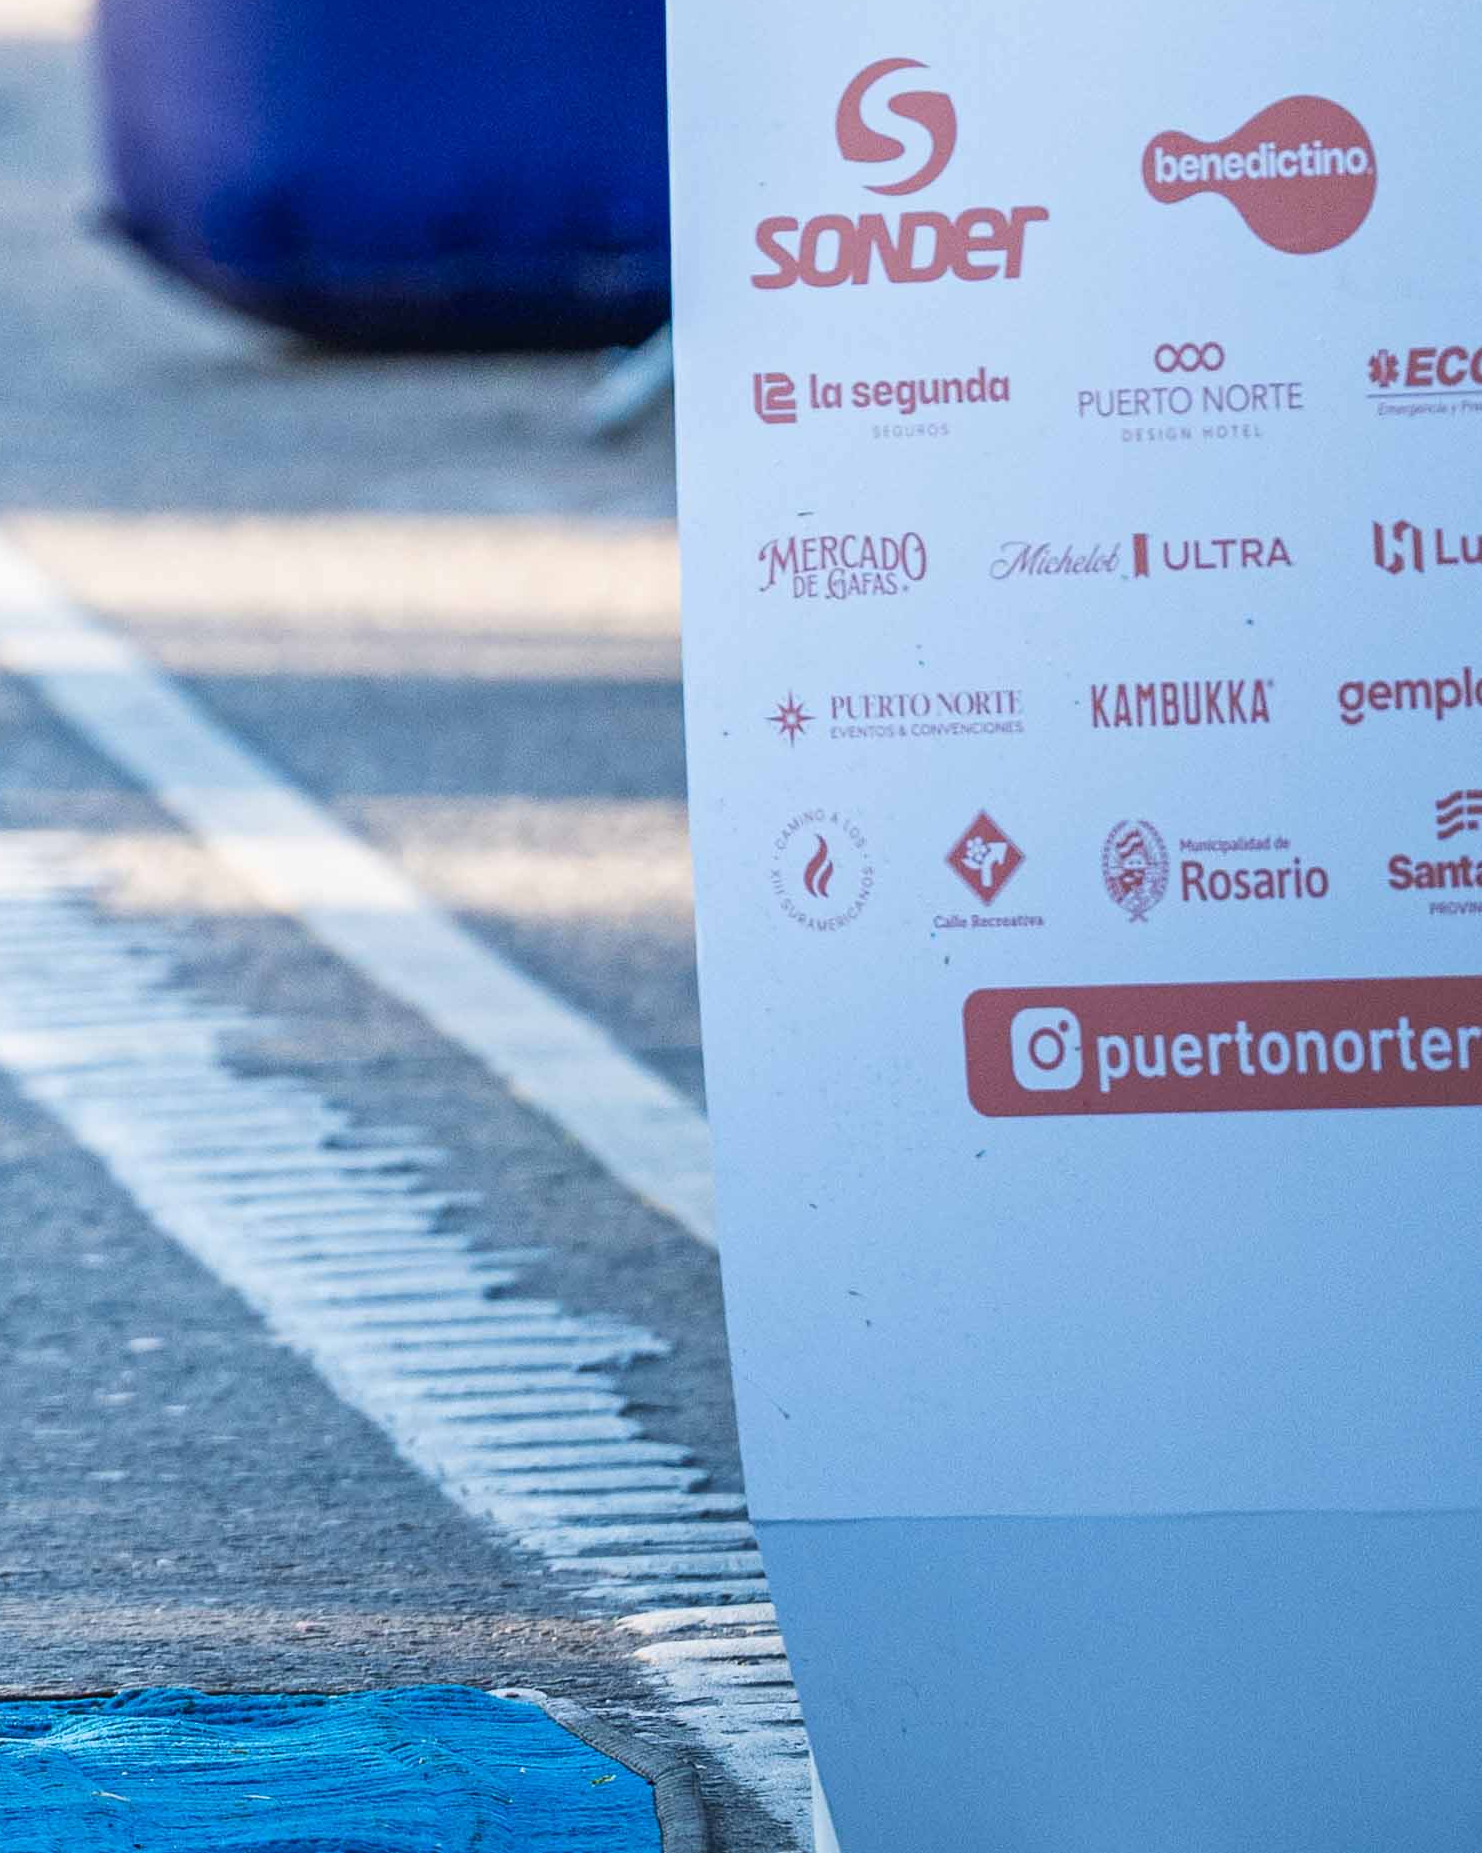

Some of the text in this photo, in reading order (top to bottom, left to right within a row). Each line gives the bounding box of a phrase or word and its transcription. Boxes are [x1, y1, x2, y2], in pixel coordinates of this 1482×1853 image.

[1155, 141, 1368, 183] benedictino
[810, 366, 1010, 415] la segunda
[1078, 382, 1304, 418] PUERTO NORTE
[873, 422, 950, 439] SEGUROS
[1122, 424, 1263, 443] DESIGN HOTEL
[758, 531, 927, 591] MERCADO
[989, 538, 1293, 580] Michelob ULTRA
[793, 567, 898, 600] DE GAFAS
[831, 690, 1023, 720] PUERTO NORTE
[1091, 679, 1270, 727] KAMBUKKA
[1339, 666, 1482, 725] gempl
[830, 726, 895, 739] EVENTOS
[910, 721, 1025, 737] CONVENCIONES
[1179, 857, 1330, 901] Rosario
[1097, 1016, 1482, 1093] puertonorter
